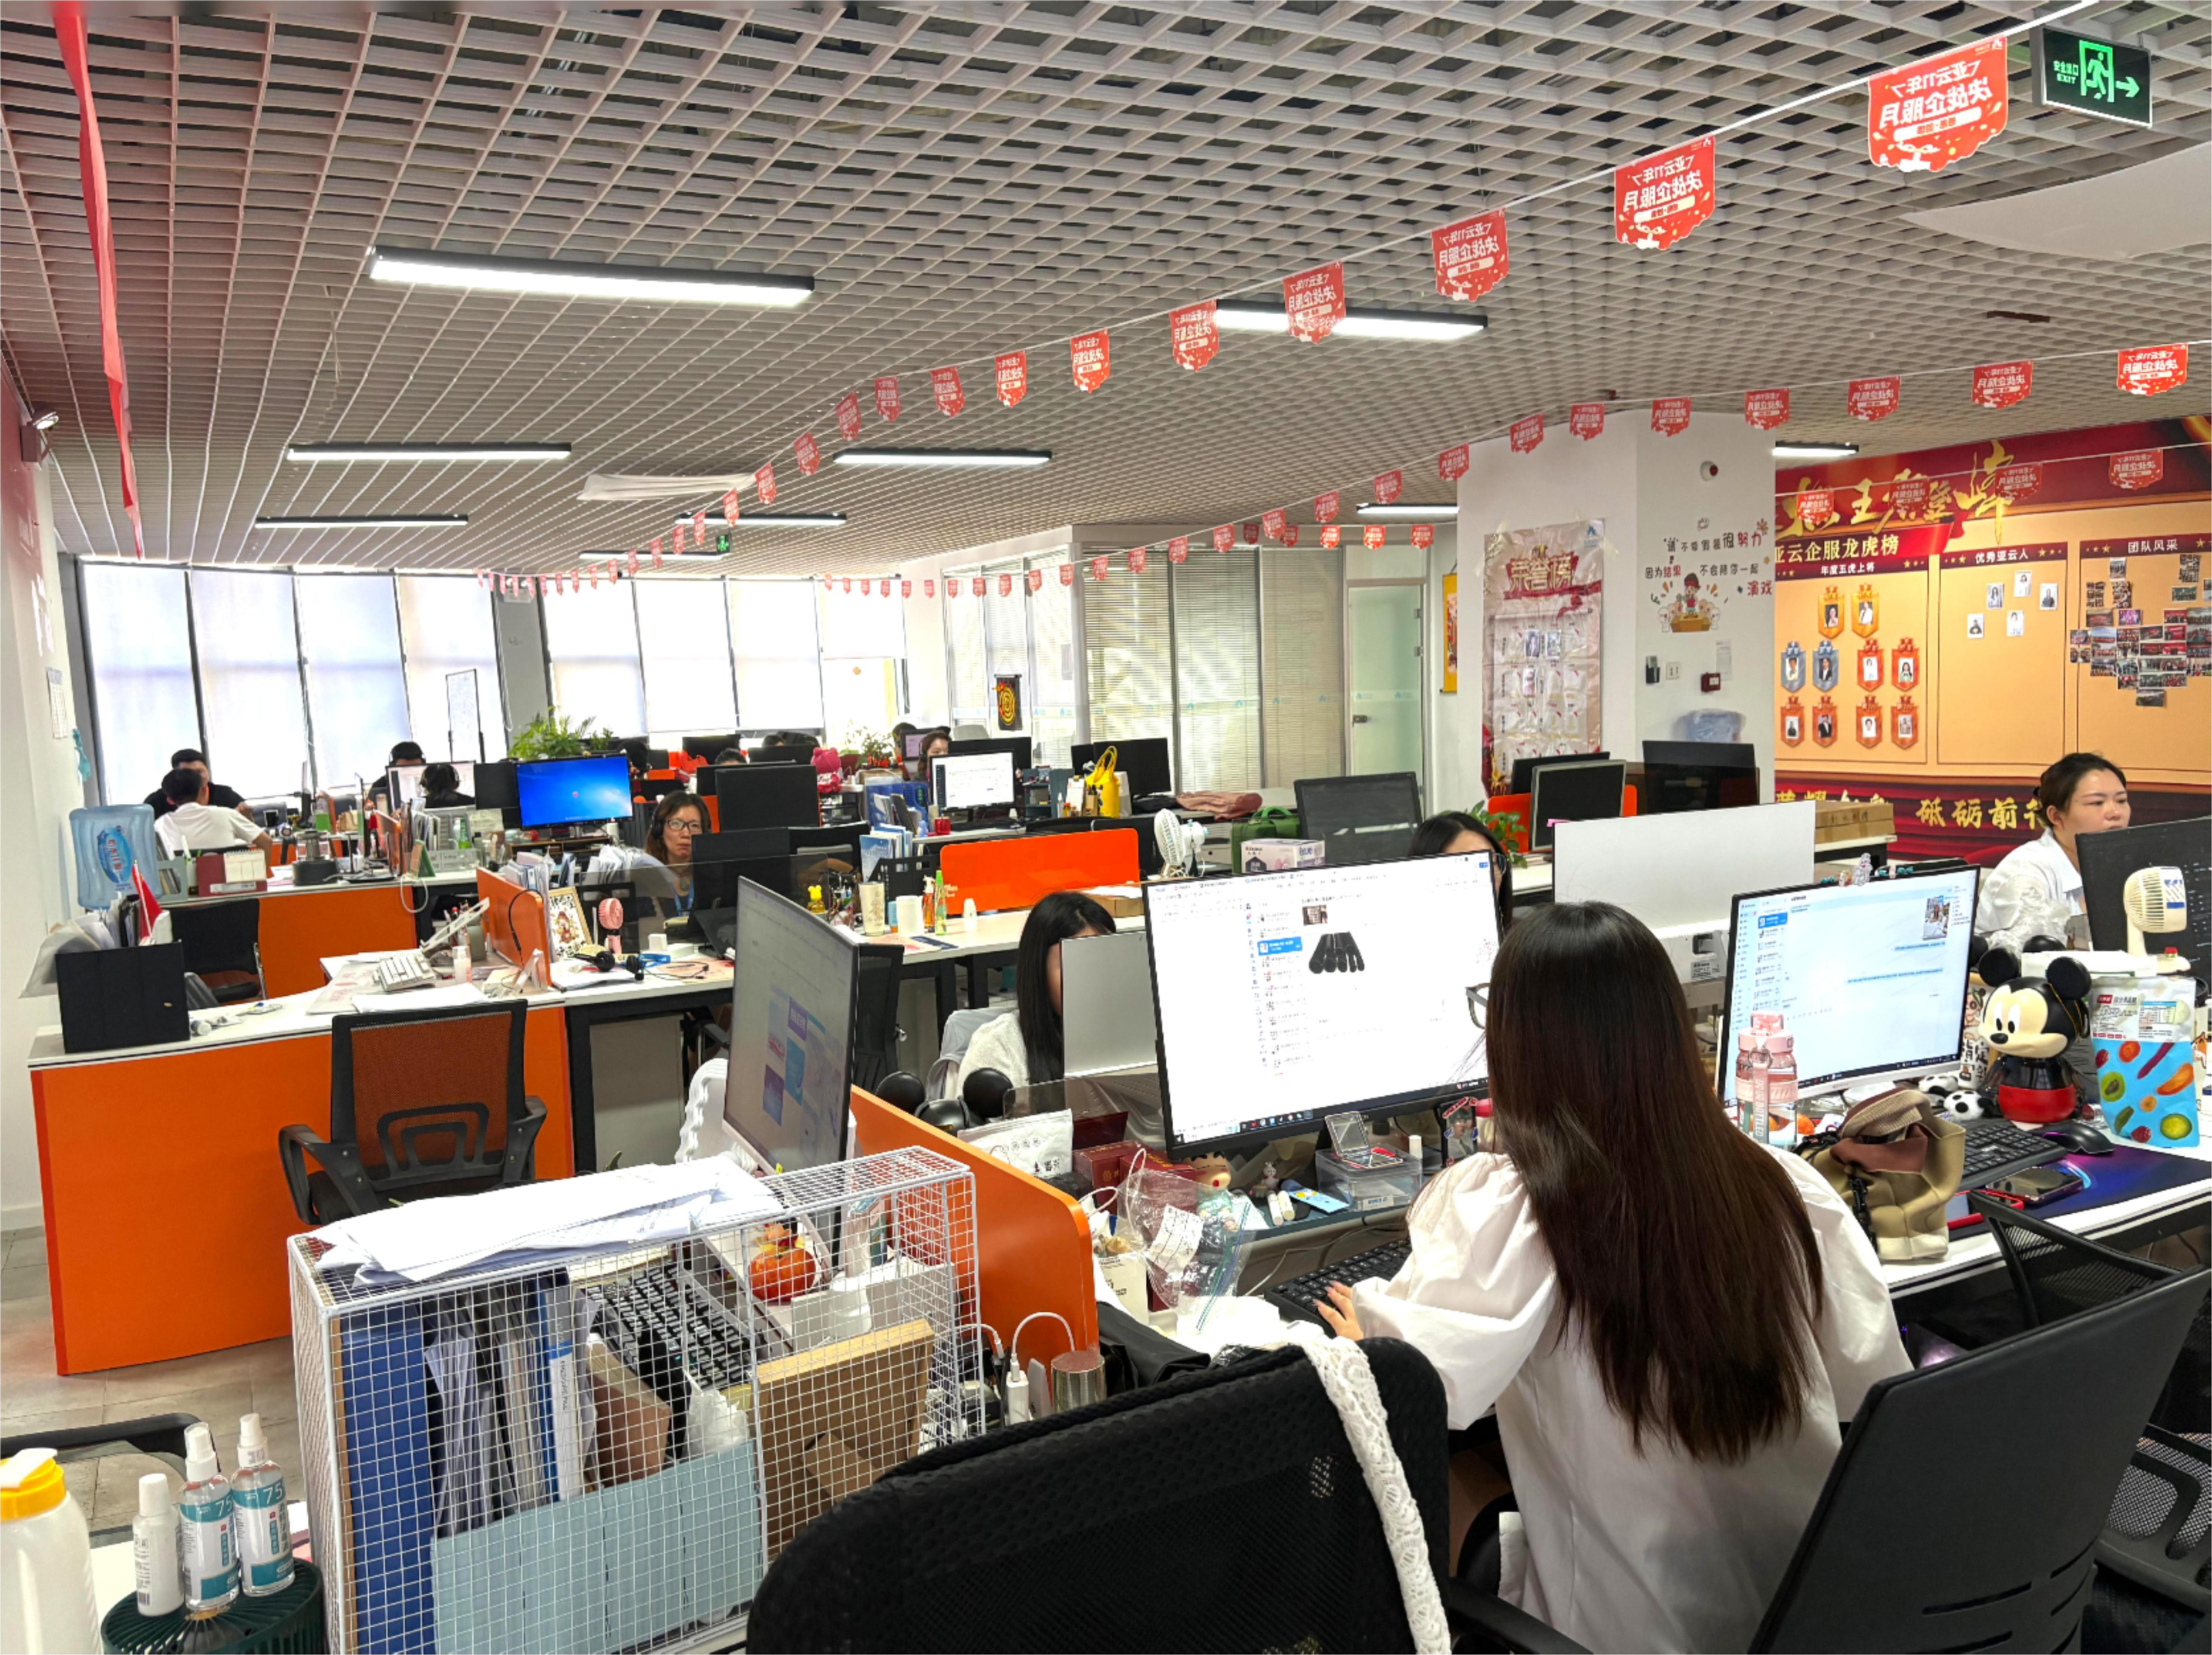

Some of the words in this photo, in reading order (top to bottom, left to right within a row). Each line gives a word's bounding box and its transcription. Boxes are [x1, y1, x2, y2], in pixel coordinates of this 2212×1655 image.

[2053, 60, 2079, 76] 安全出口
[2057, 73, 2076, 85] EXIT
[1775, 533, 1899, 563] 亚云企服龙虎榜
[2128, 539, 2178, 554] 团队风采
[1975, 548, 2029, 564] 优秀亚云人
[1510, 555, 1573, 592] 荣誉榜
[1645, 565, 1681, 579] 因为结果
[1821, 562, 1875, 576] 年度五虎上将
[1747, 580, 1772, 597] 演戏
